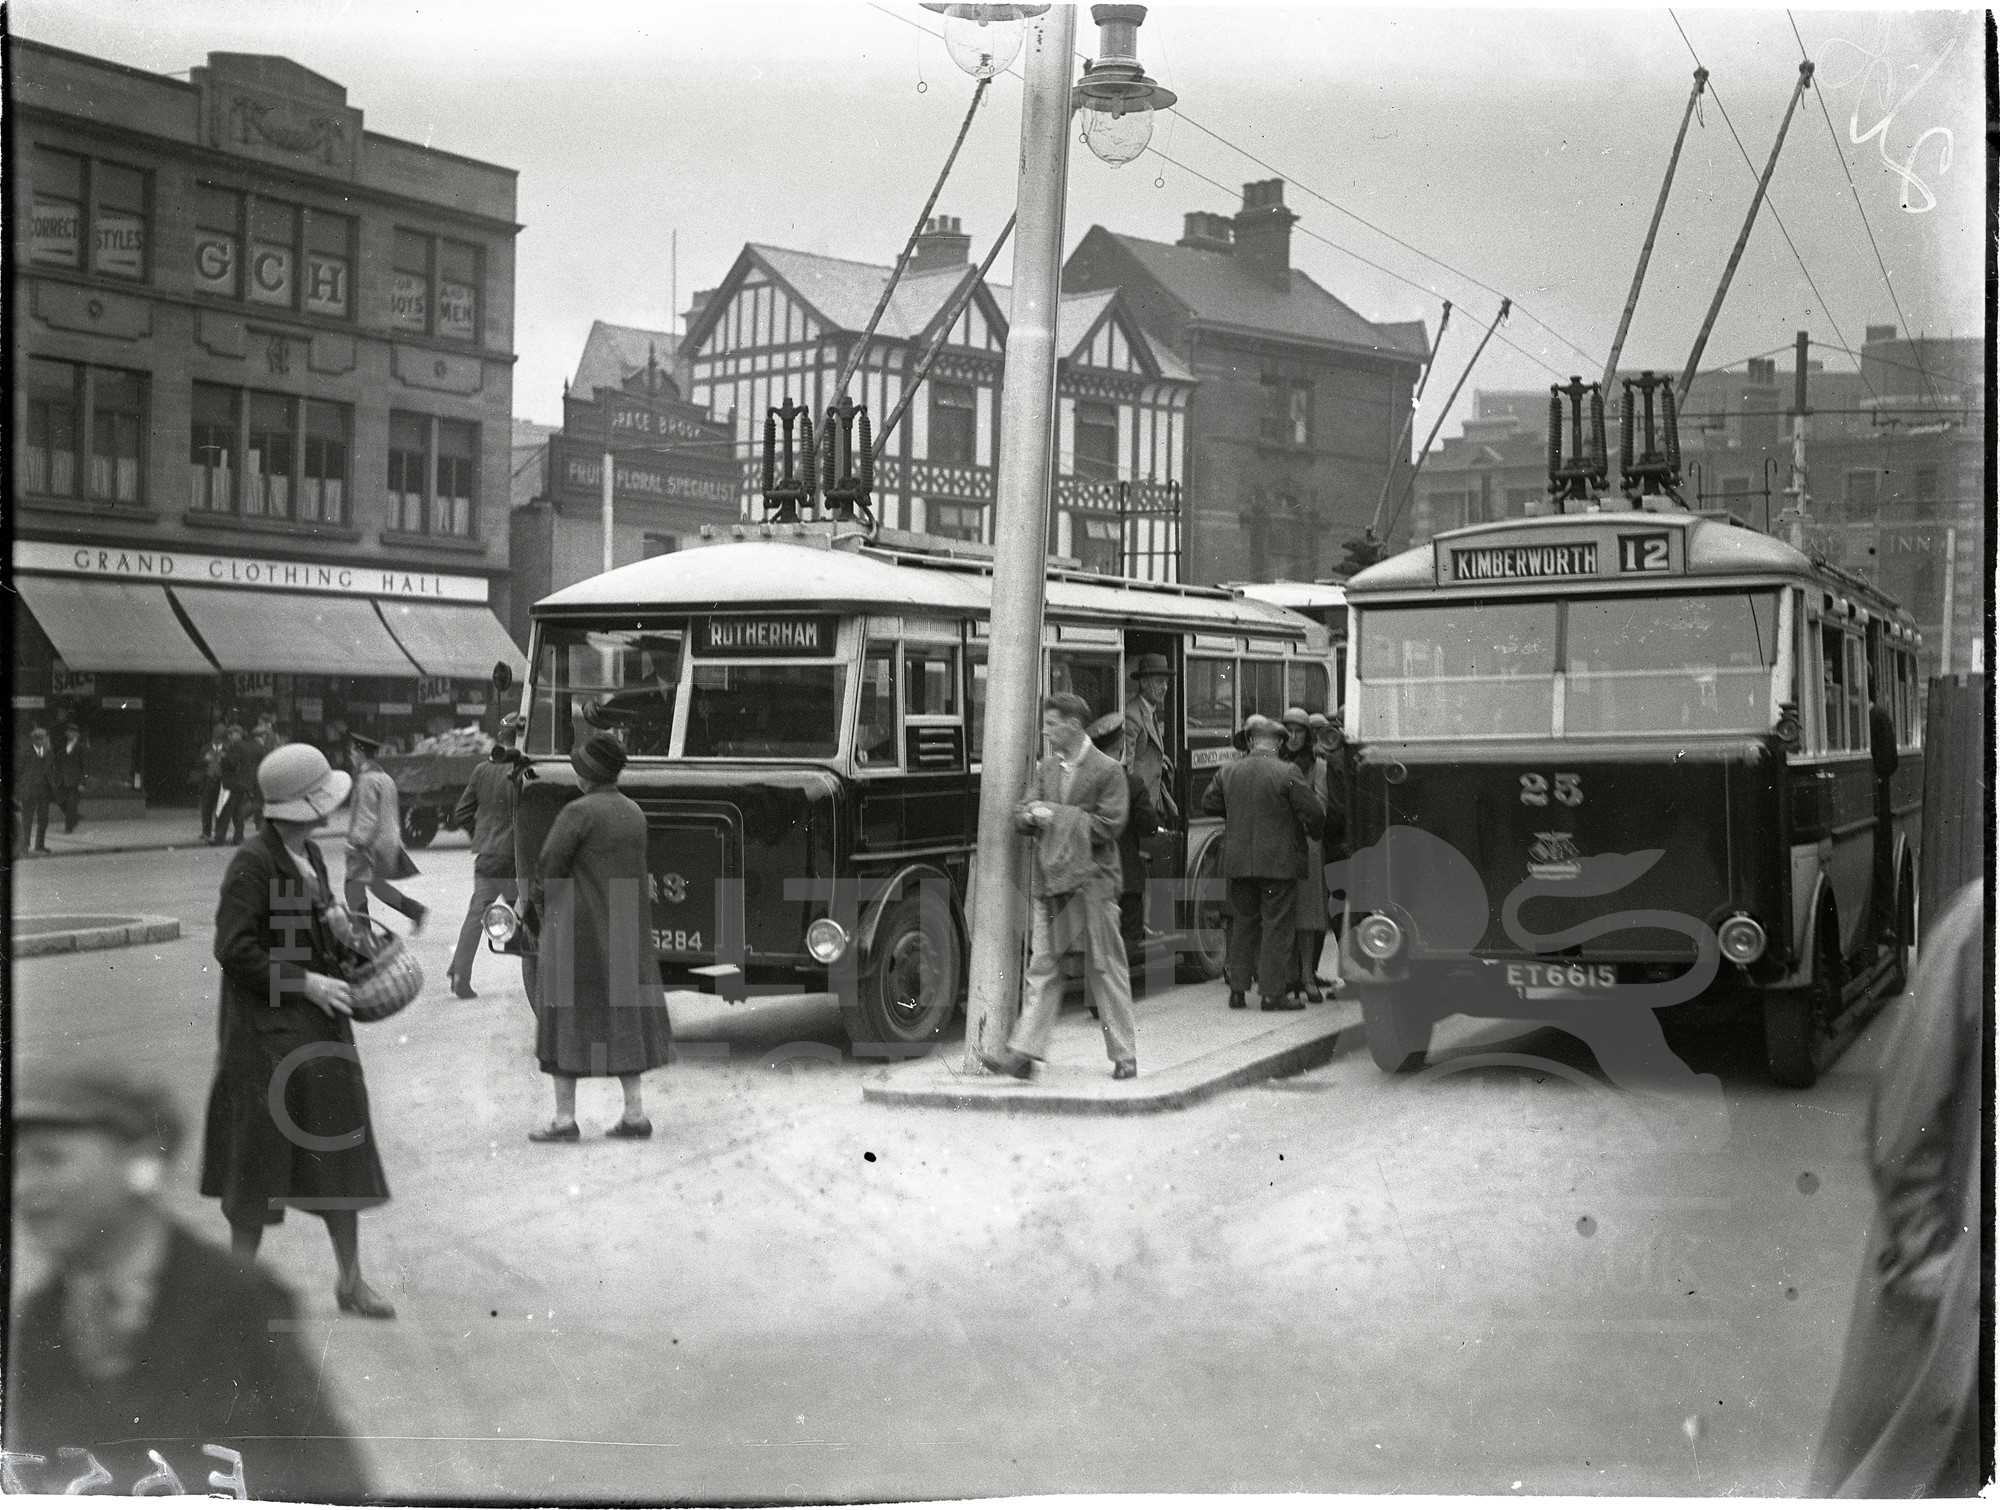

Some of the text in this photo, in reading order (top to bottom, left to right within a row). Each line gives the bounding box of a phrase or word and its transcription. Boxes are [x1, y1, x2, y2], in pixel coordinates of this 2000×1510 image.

[32, 215, 142, 250] CORRECT STYLES
[616, 469, 663, 494] FLORAL
[666, 475, 737, 503] SPECIALIST
[1457, 546, 1597, 580] KIMBERWORTH
[1624, 539, 1668, 571] 12
[74, 549, 443, 596] GRAND CLOTHING HALL
[1519, 773, 1584, 806] 25
[1507, 964, 1616, 987] ET6615
